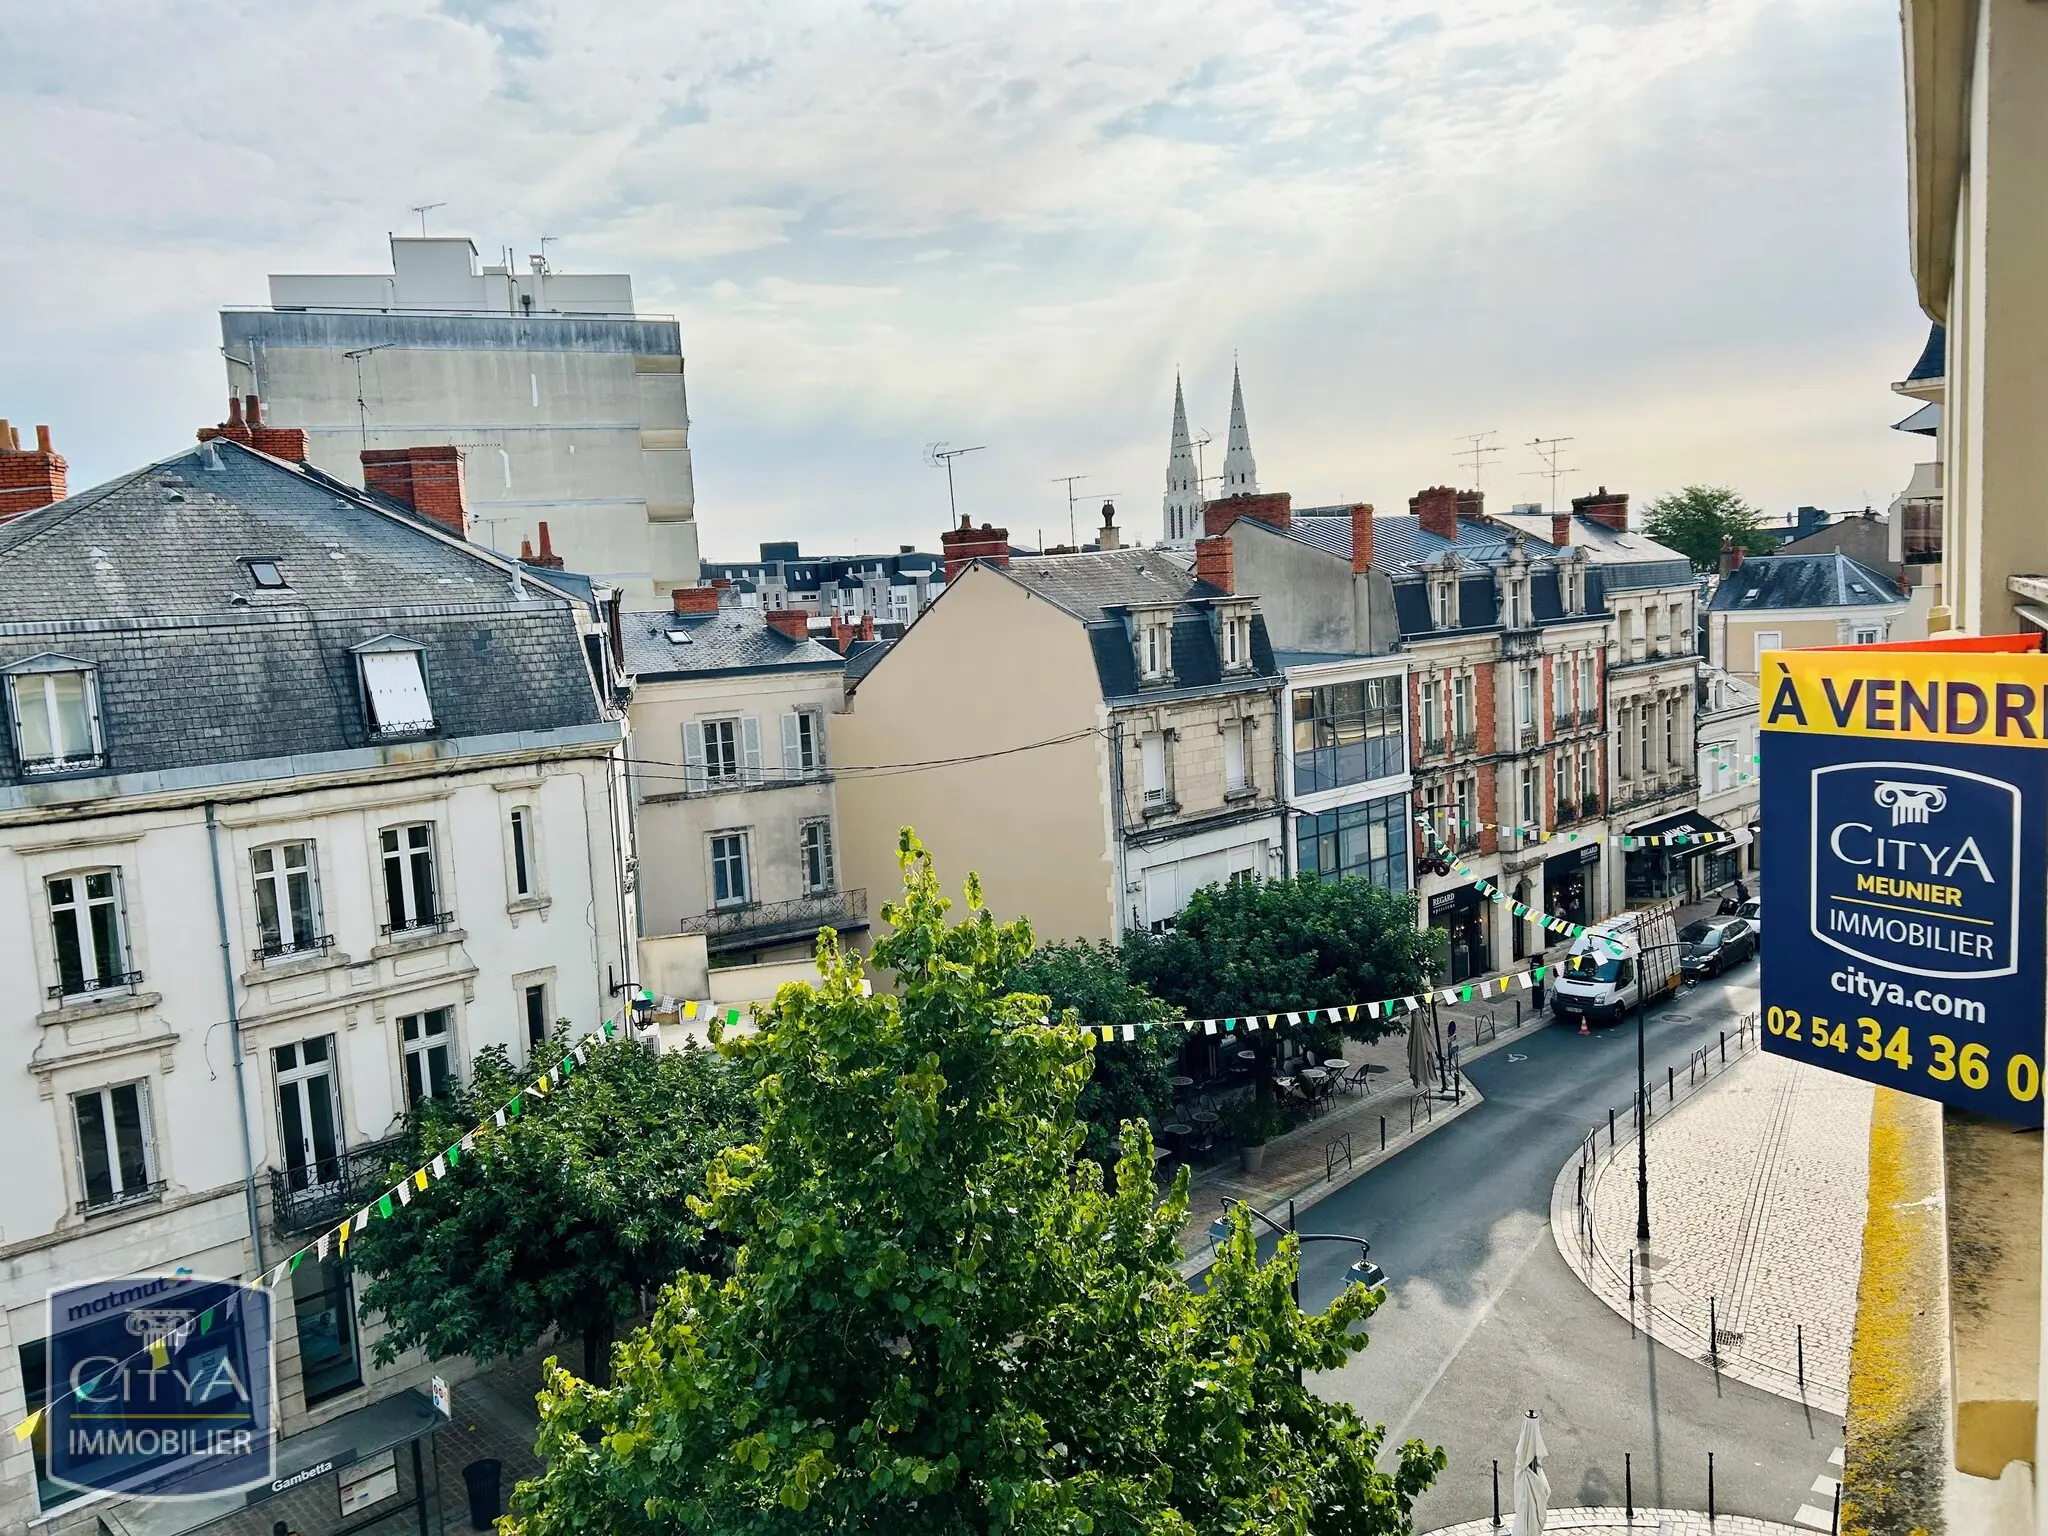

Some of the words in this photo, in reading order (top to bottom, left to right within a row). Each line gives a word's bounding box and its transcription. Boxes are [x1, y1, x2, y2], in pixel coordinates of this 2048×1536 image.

[1767, 662, 1808, 726] À
[1821, 678, 2048, 739] VENDR
[1830, 822, 1995, 883] CITYA
[1856, 873, 1962, 907] MEUNIER
[1830, 908, 1994, 960] IMMOBILIER
[1830, 966, 1986, 1024] citya.com
[1767, 1005, 1802, 1042] 02
[1811, 1016, 1848, 1054] 54
[1856, 1017, 1913, 1071] 34
[1927, 1035, 1990, 1090] 36
[2006, 1053, 2045, 1101] 0
[67, 1276, 169, 1321] matmut
[271, 1461, 333, 1492] Gambetta
